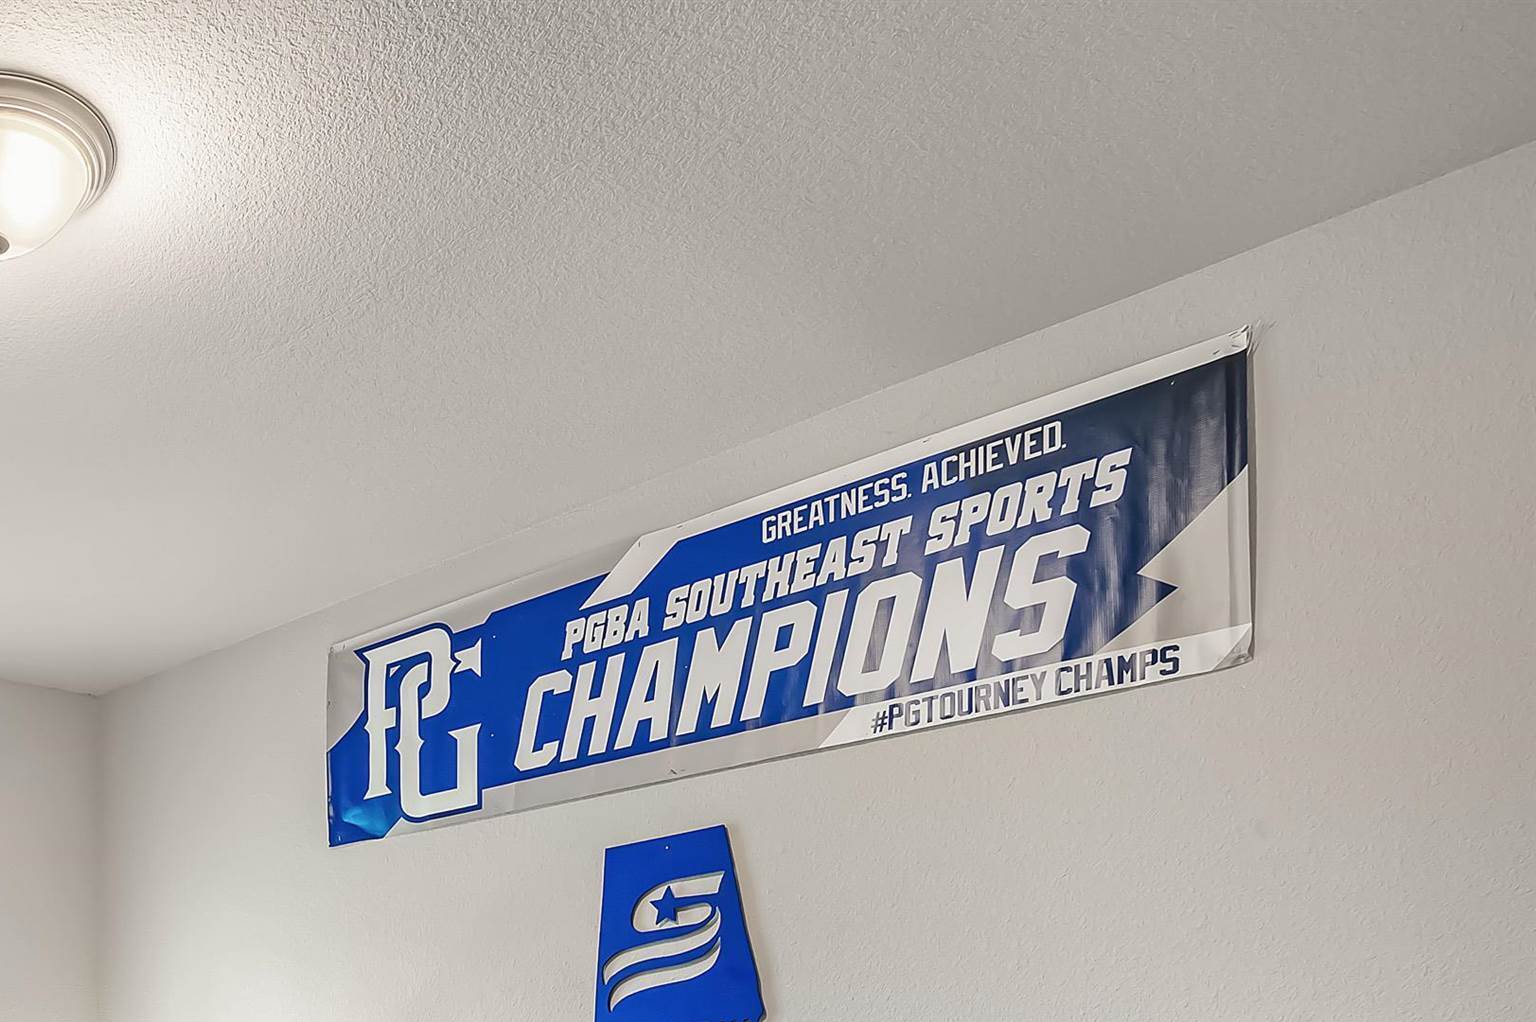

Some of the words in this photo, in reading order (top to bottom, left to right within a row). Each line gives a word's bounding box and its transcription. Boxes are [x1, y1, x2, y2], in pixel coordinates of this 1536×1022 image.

[562, 606, 651, 661] PGBA
[662, 516, 914, 629] SOUTHEAST
[926, 447, 1133, 546] SPORTS
[761, 473, 912, 545] GREATNESS.
[921, 419, 1067, 494] ACHIEVED.
[512, 522, 1092, 772] CHAMPIONS
[870, 669, 1047, 736] #PGTOURNEY
[1055, 644, 1182, 699] CHAMPS
